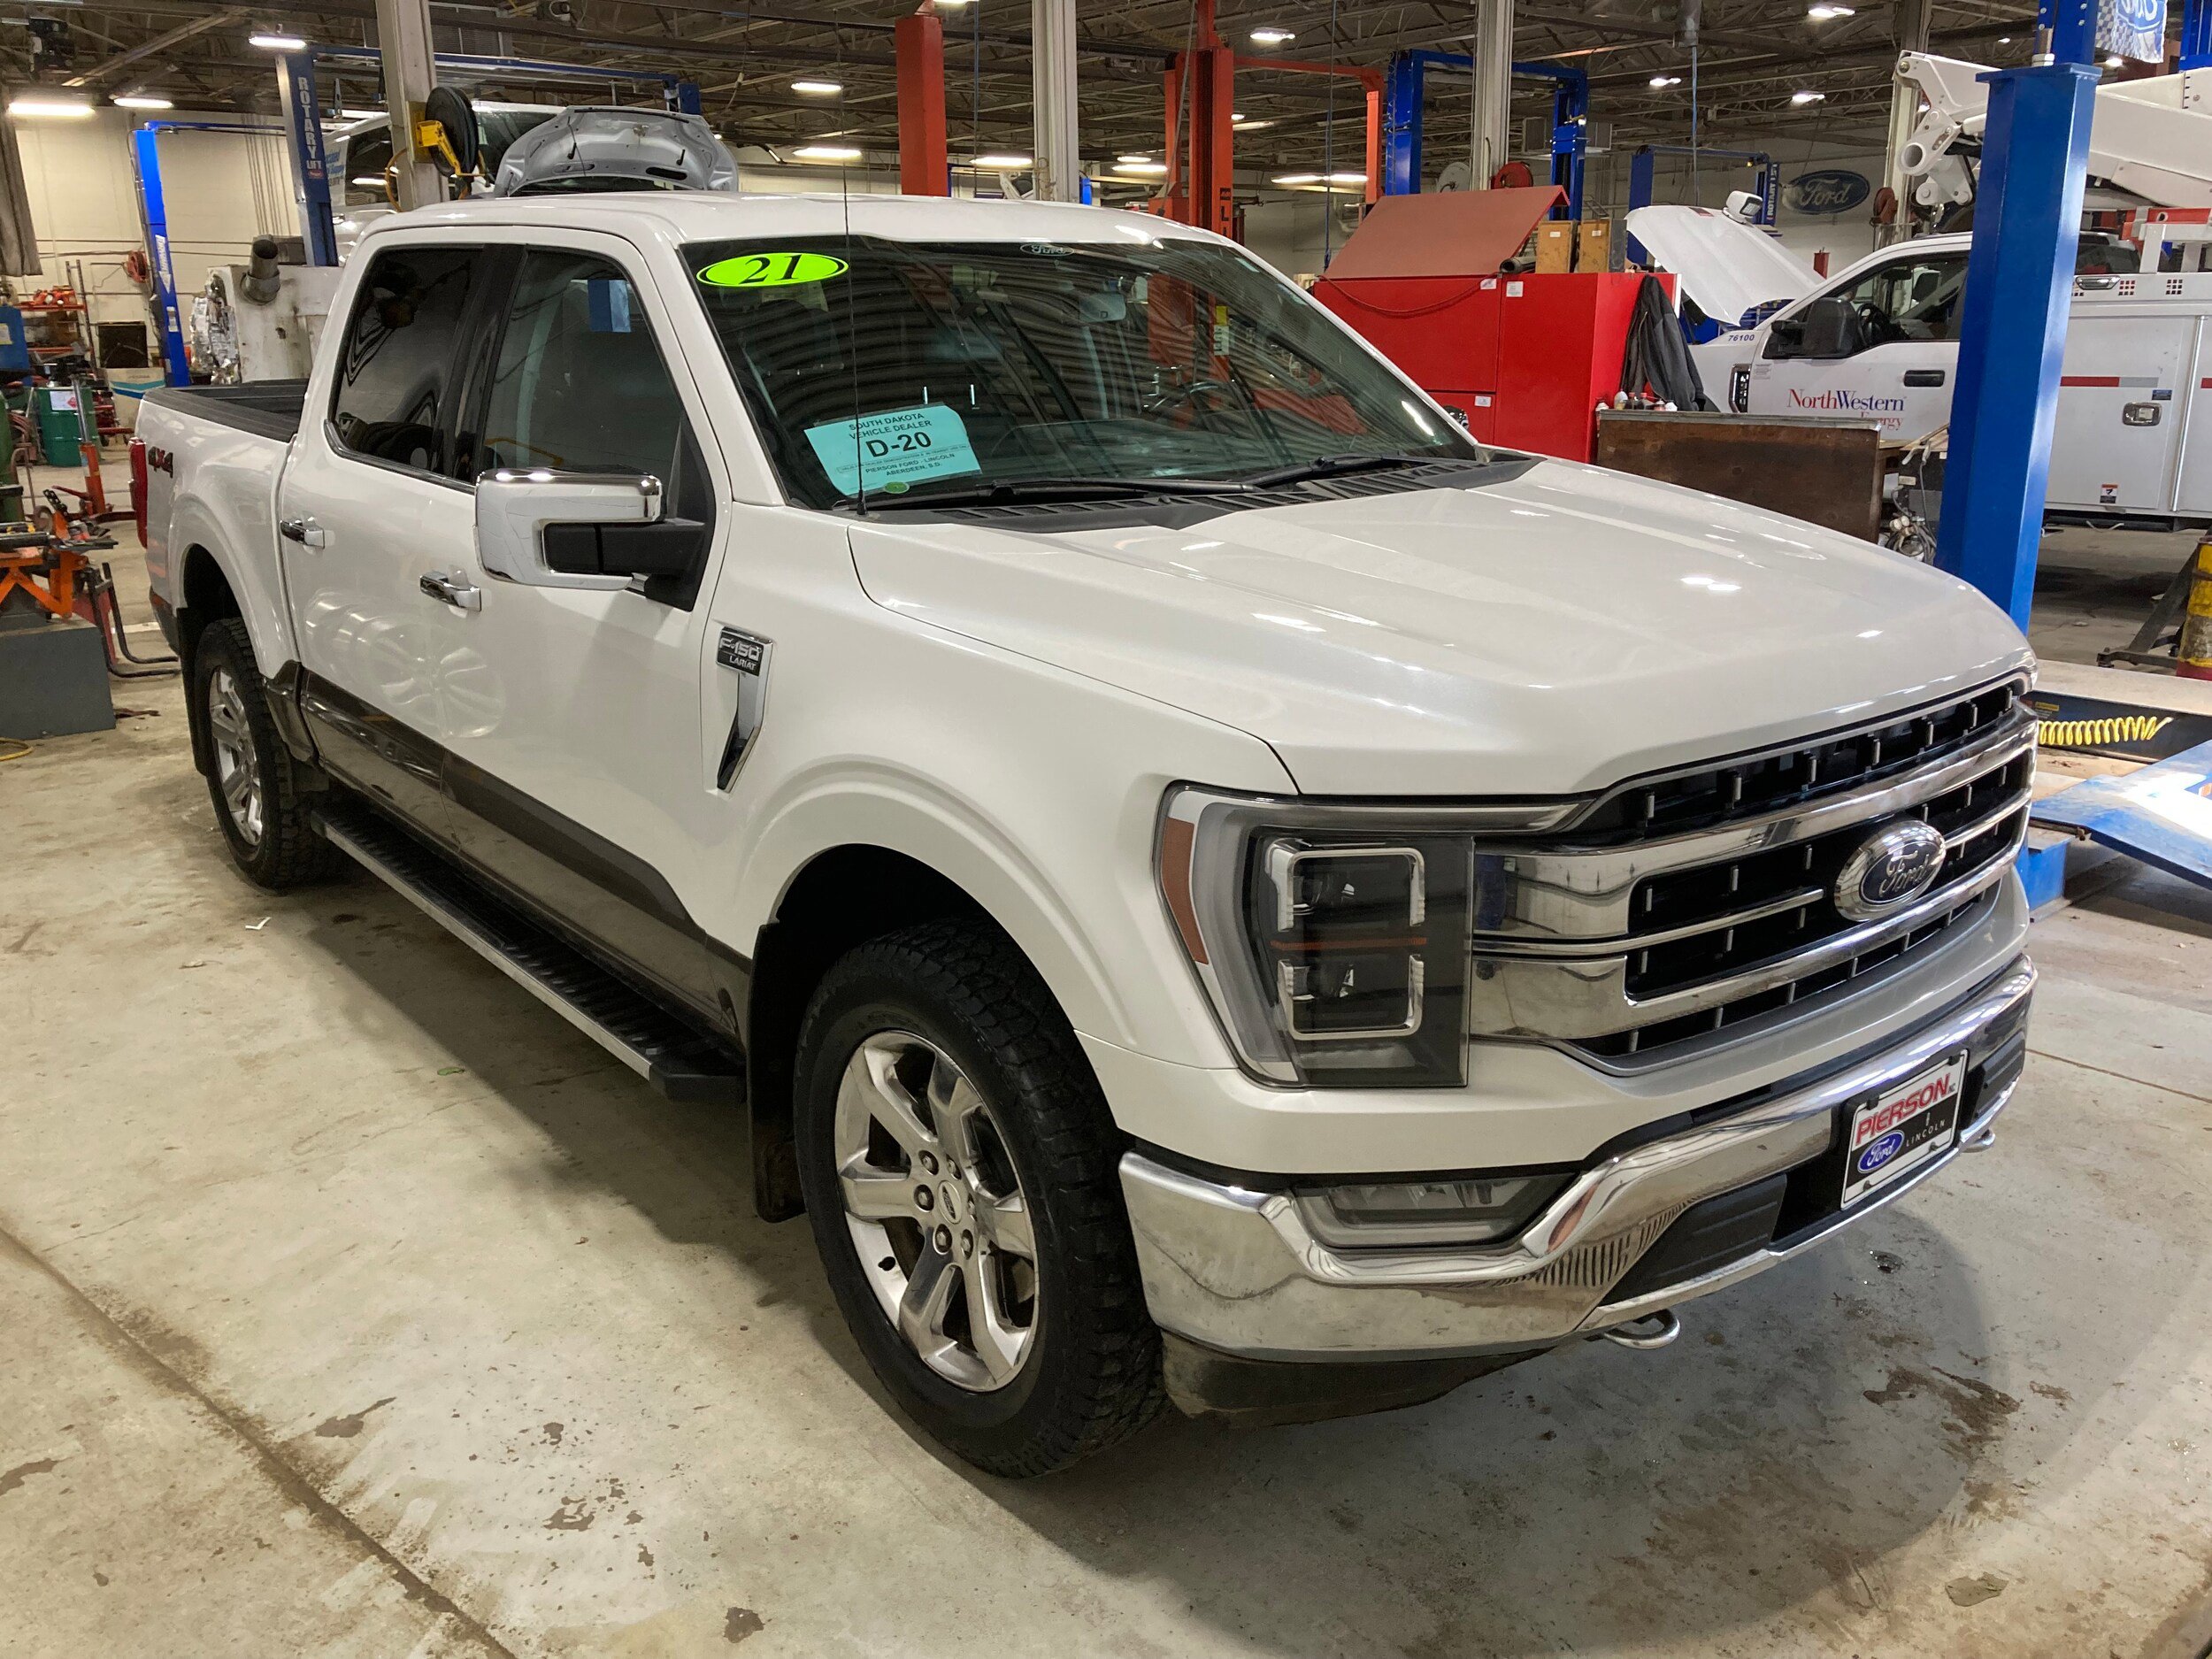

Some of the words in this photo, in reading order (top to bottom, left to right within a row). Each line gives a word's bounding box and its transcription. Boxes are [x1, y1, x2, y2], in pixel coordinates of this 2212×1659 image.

[297, 76, 318, 159] ROTARY
[306, 160, 322, 170] LIFT
[1800, 178, 1854, 206] Ford
[739, 254, 803, 285] 21
[1787, 388, 1905, 411] NorthWestern
[849, 419, 883, 431] SOUTH
[884, 412, 925, 424] DAKOTA
[849, 426, 892, 440] VEHICLE
[893, 419, 933, 432] DEALER
[865, 431, 932, 457] D-20
[865, 464, 897, 473] PIERSON
[924, 453, 956, 463] LINCOLN
[718, 637, 761, 662] F-150
[729, 655, 757, 671] LARIAT
[1878, 849, 1930, 898] Ford
[1855, 1072, 1950, 1147] PIERSON
[1906, 1119, 1946, 1148] LINCOLN
[1866, 1138, 1896, 1167] Ford
